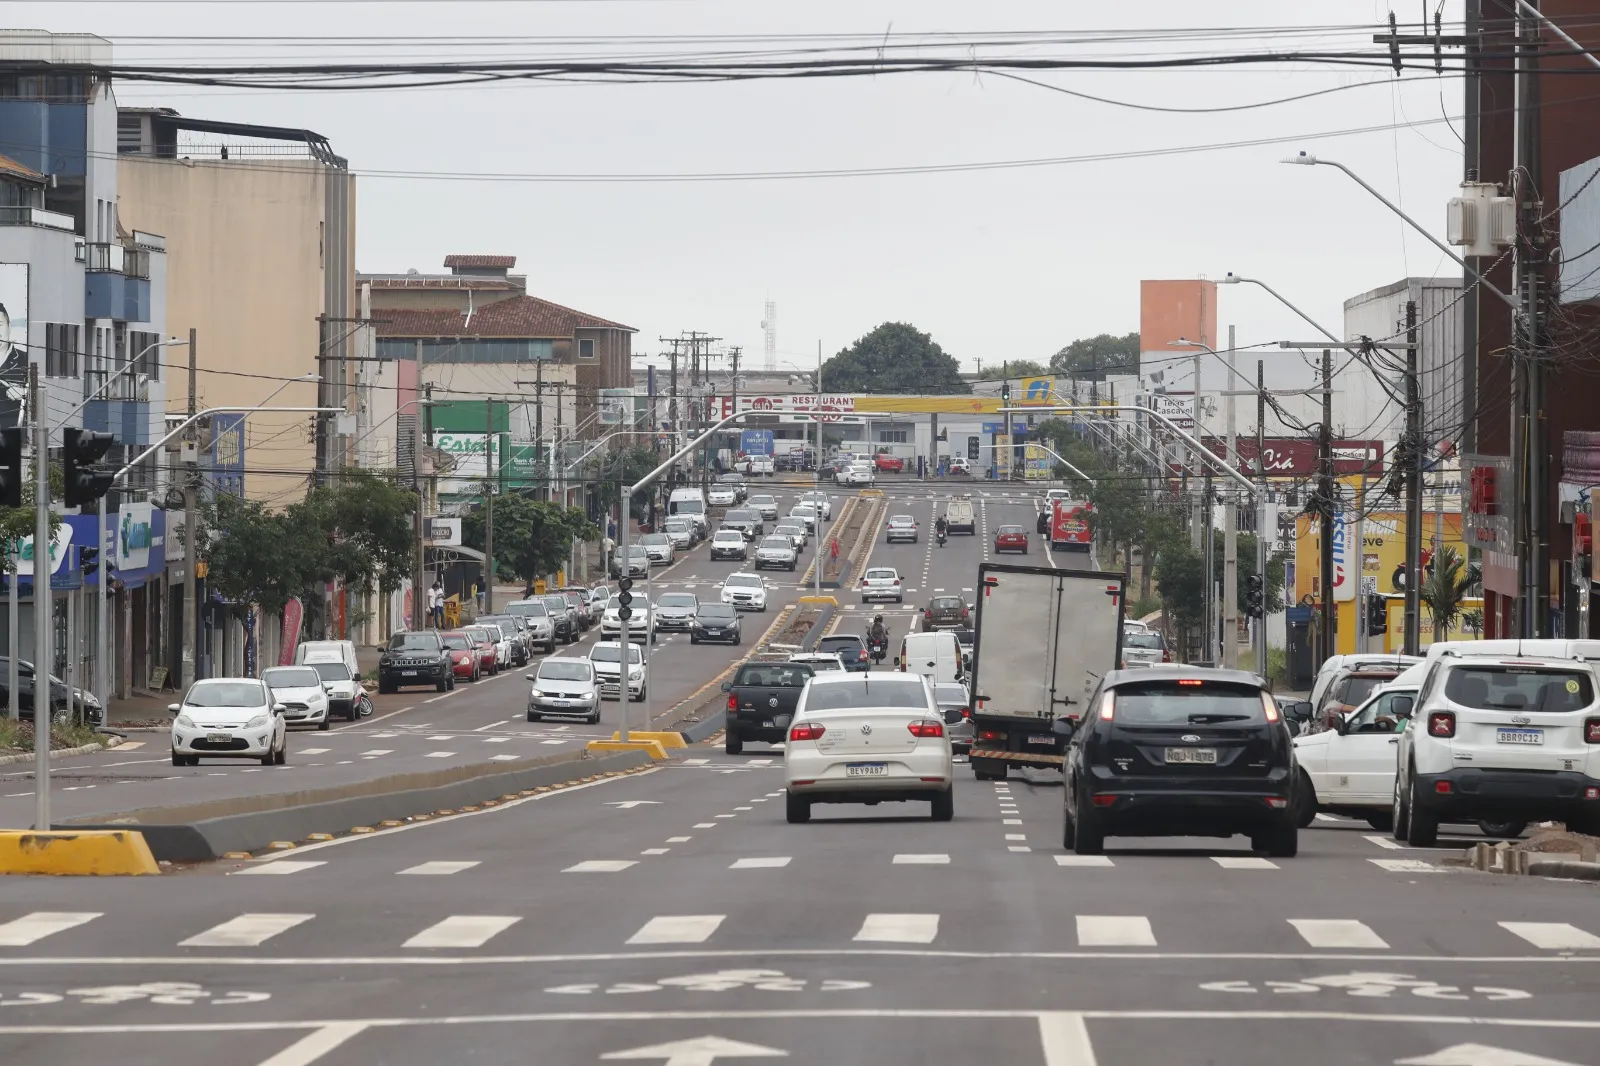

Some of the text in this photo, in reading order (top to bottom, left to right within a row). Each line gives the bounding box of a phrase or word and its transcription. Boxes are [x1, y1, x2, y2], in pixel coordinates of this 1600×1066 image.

[792, 397, 854, 405] RESTURANT
[1157, 406, 1193, 415] Cascavel
[1263, 449, 1295, 470] Cia
[1398, 625, 1434, 634] EESS
[850, 766, 884, 775] BEY9A87
